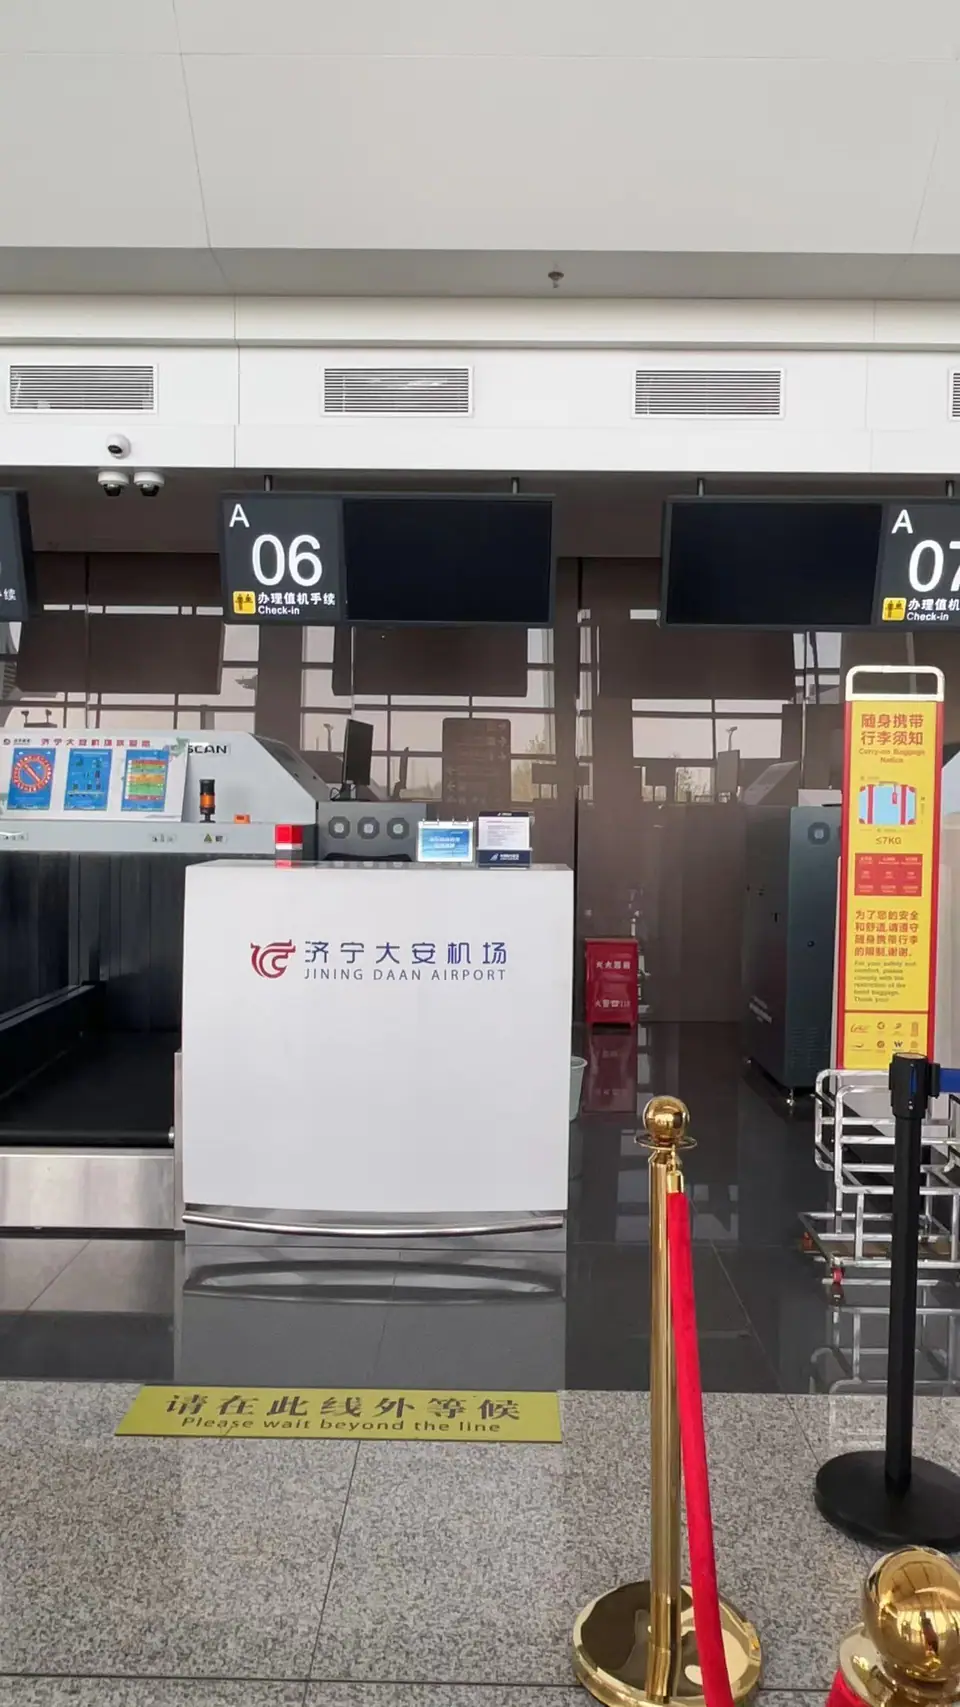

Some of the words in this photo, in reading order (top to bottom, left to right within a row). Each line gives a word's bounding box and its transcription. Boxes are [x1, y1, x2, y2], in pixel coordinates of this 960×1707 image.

[229, 503, 250, 527] A
[891, 509, 913, 534] A
[252, 534, 323, 586] 06
[257, 591, 336, 606] 办理值机手续
[257, 605, 300, 615] Check-in
[906, 611, 949, 621] Check-in
[861, 713, 924, 729] 随身携带
[861, 731, 924, 746] 行李须知
[855, 910, 919, 920] 为了您的安全
[304, 941, 507, 964] 济宁大安机场
[304, 969, 364, 981] JINING
[373, 969, 421, 981] DAAN
[431, 969, 506, 981] AIRPORT
[165, 1394, 520, 1420] 请在此线外等候
[182, 1416, 254, 1430] Please
[263, 1417, 309, 1430] wait
[320, 1417, 404, 1433] beyond
[414, 1419, 449, 1432] the
[458, 1420, 500, 1433] line
